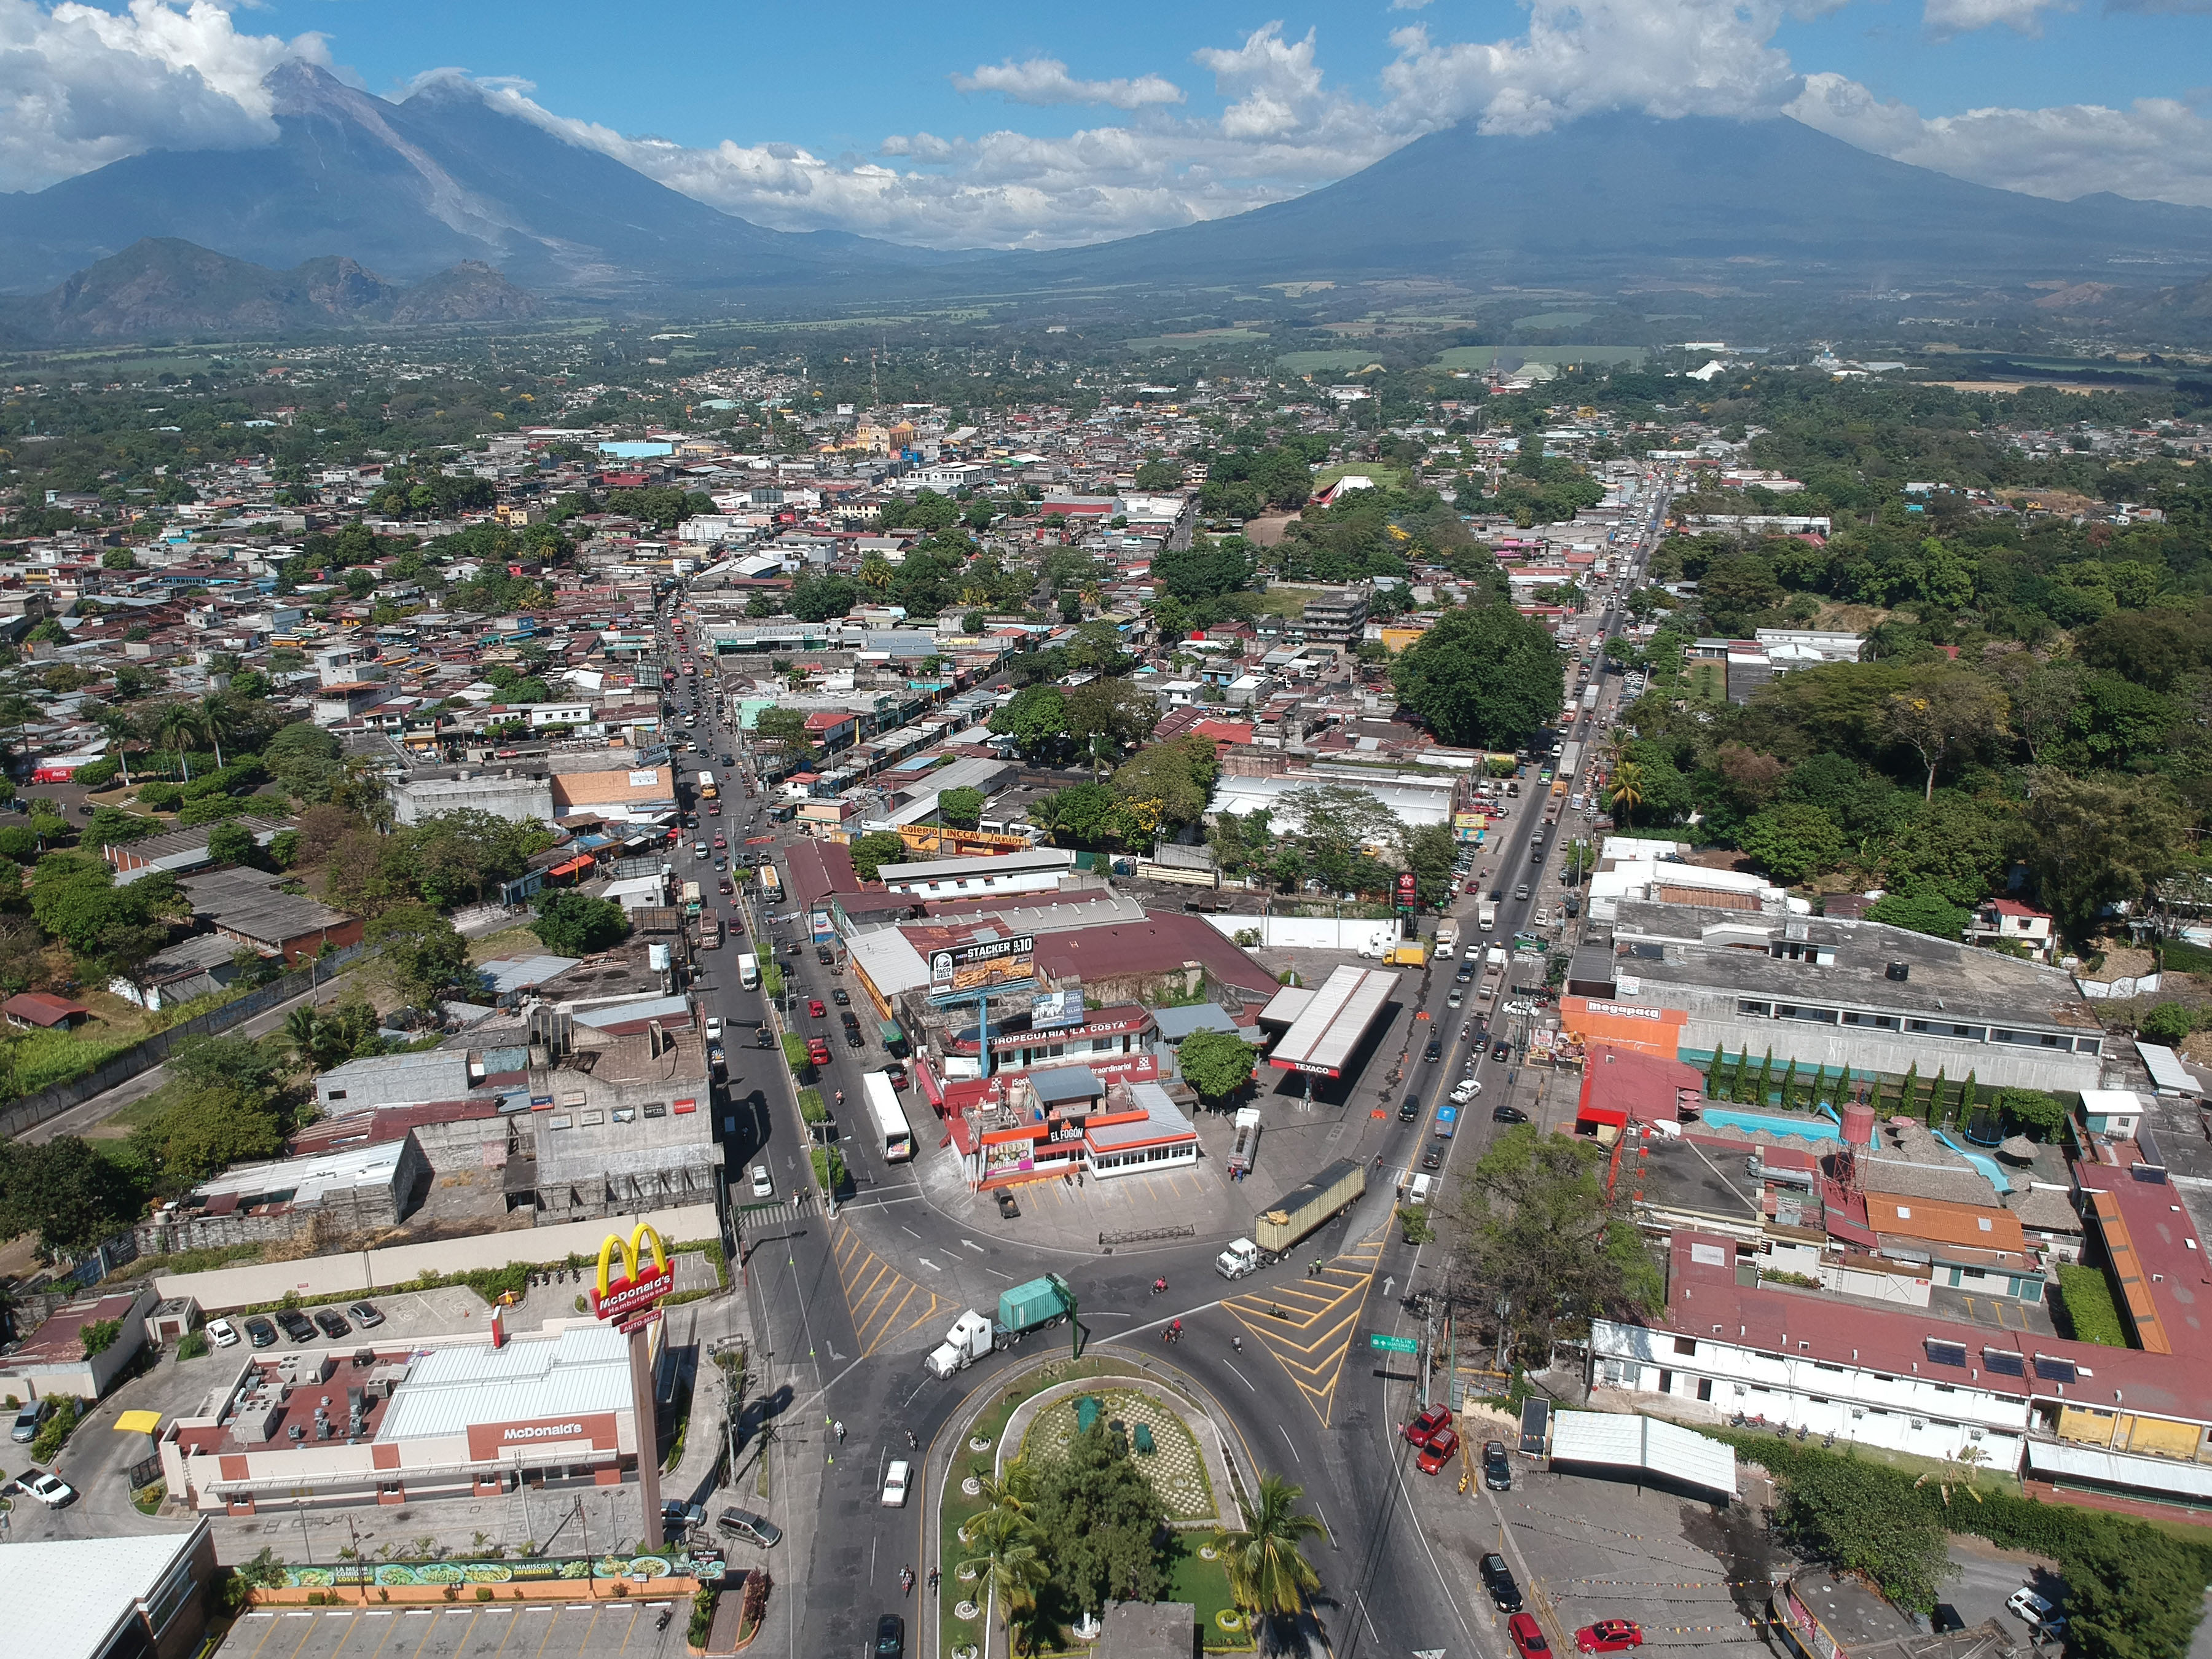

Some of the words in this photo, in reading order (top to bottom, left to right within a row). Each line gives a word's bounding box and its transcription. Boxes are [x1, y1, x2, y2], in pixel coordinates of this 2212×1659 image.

[901, 825, 938, 836] Colegio
[947, 830, 981, 840] INCCAV
[988, 833, 1024, 844] Junior
[967, 942, 1011, 958] STACKER
[1588, 1001, 1660, 1019] megapaca
[1294, 1062, 1329, 1074] TEXACO
[1050, 1132, 1060, 1142] EL
[1060, 1126, 1084, 1140] FOGÓN
[599, 1274, 670, 1311] McDonald's
[608, 1285, 668, 1314] Hamburguesas
[504, 1423, 582, 1440] McDonald's
